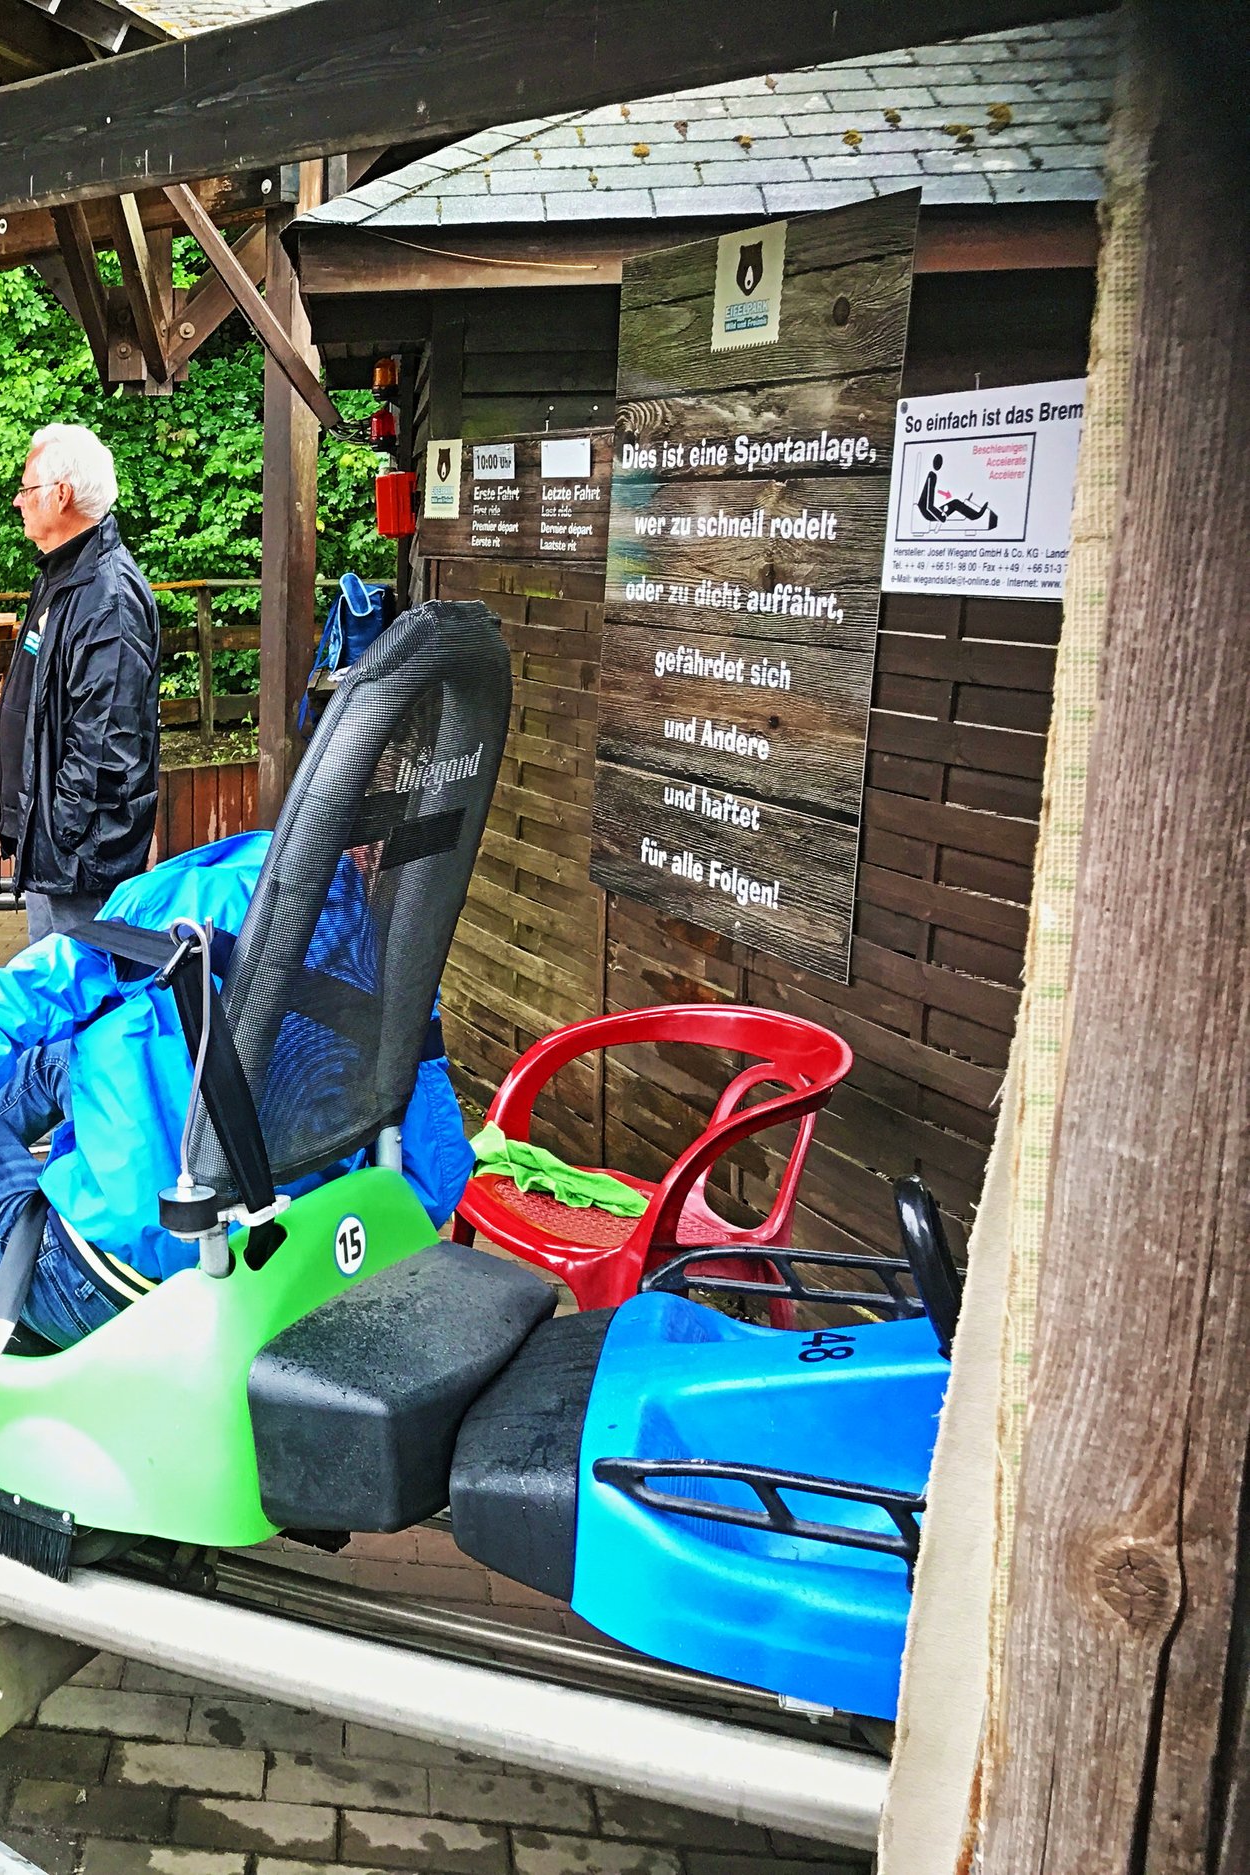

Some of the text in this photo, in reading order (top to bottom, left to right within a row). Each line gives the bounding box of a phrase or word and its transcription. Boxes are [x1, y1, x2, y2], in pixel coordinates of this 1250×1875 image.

[905, 415, 922, 433] So
[926, 410, 977, 431] einfach
[982, 407, 1001, 427] ist
[1005, 405, 1033, 424] das
[621, 431, 877, 472] Dies ist eine Sportanlage,
[476, 454, 512, 470] 10:00 Uhr
[473, 485, 520, 500] Erste Fahrt
[542, 484, 601, 501] Letzte Fahrt
[472, 505, 487, 516] First
[541, 504, 573, 517] Last ride
[472, 520, 519, 535] Premier départ
[540, 521, 593, 538] Dernier départ
[635, 509, 837, 540] wer zu schnell rodelt
[471, 535, 501, 548] Eerste rit
[540, 538, 577, 552] Laatste rit
[927, 547, 946, 557] Josef
[947, 548, 977, 560] Wiegand
[979, 548, 1002, 558] GmbH
[1011, 548, 1024, 558] Co.
[1026, 549, 1039, 558] KG
[982, 562, 996, 572] Fax
[1007, 577, 1038, 588] Internet:
[626, 575, 844, 623] oder zu dicht auffährt,
[654, 645, 791, 690] gefährdet sich
[664, 717, 770, 760] und Andere
[395, 742, 483, 795] Wiegand
[664, 786, 760, 830] und haftet
[640, 837, 780, 910] für alle Folgen!
[338, 1225, 362, 1264] 15
[798, 1332, 857, 1363] 48
